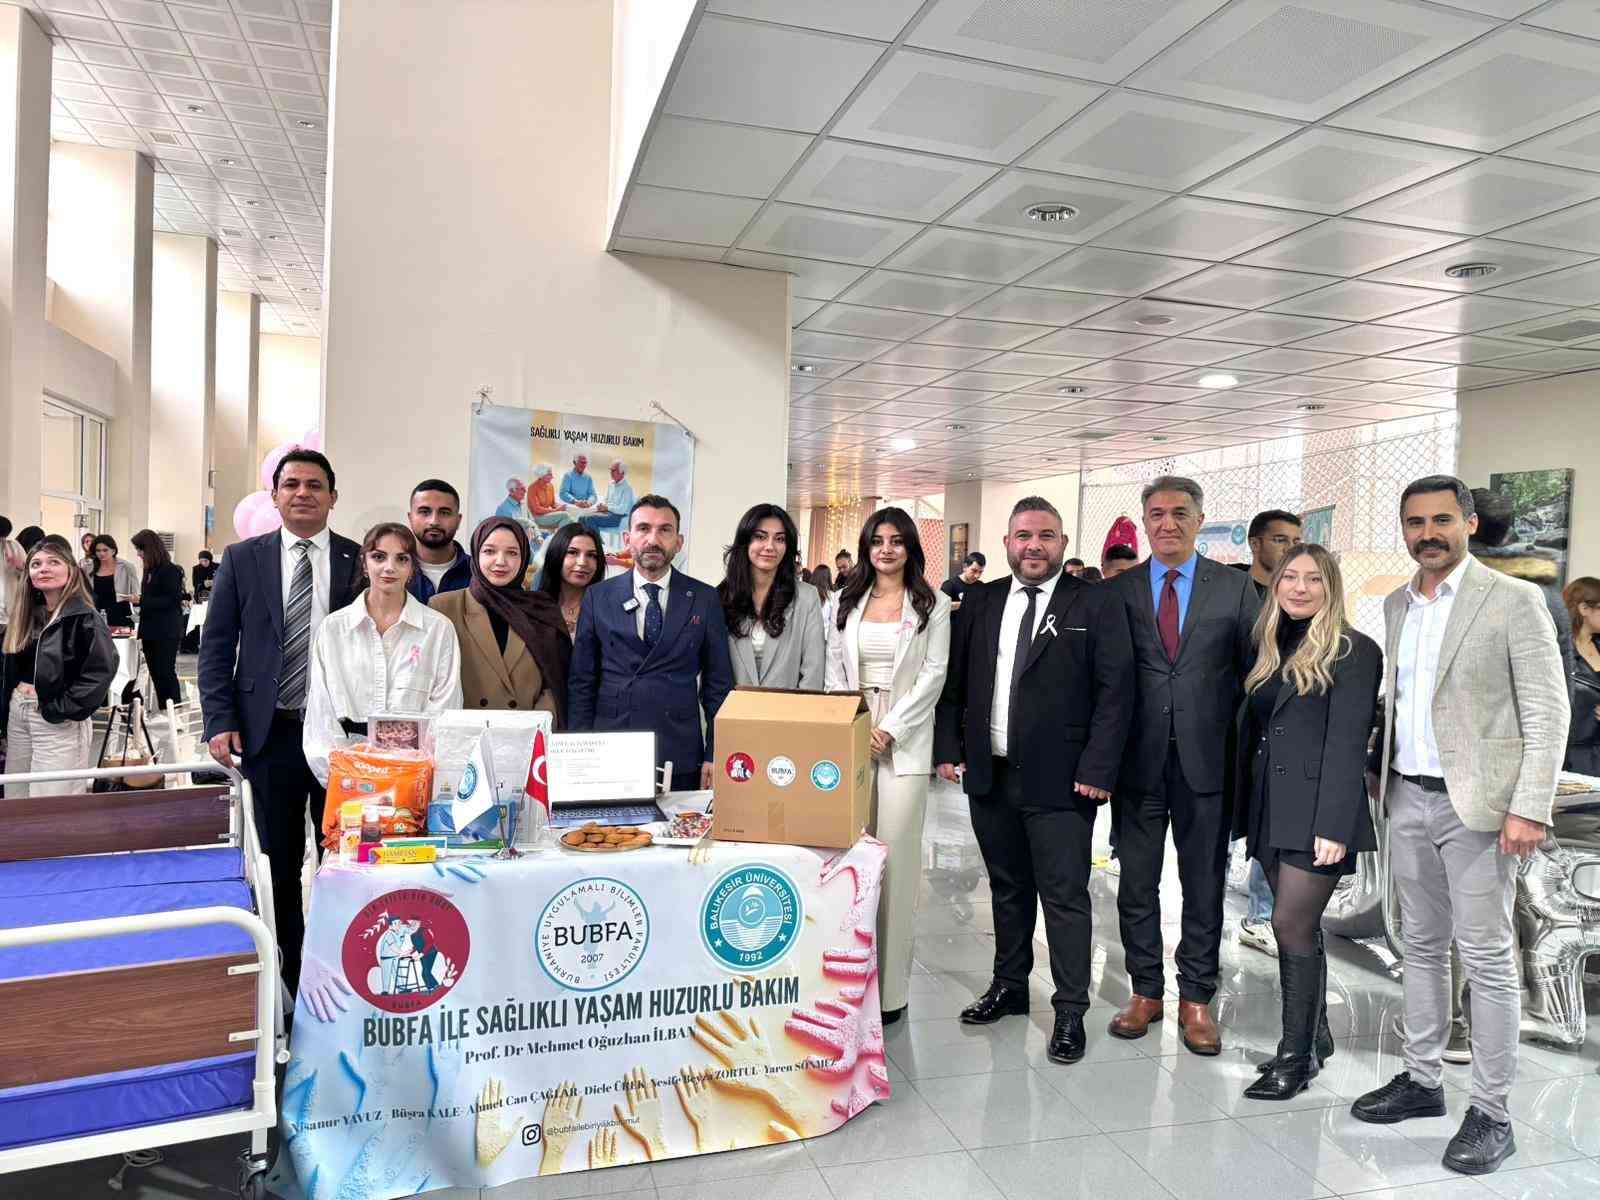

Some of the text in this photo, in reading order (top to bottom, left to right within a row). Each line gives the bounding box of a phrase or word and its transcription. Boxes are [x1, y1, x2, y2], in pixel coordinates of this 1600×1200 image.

[530, 425, 645, 448] SAĞLIKLI YAŞAM HUZURLU BAKIM
[544, 883, 605, 928] UYGULAMALI
[710, 872, 793, 929] BALIKESİR ÜNİVERSİTESİ
[553, 920, 633, 947] BUBFA
[580, 953, 604, 964] 2007
[740, 951, 764, 962] 1992
[363, 976, 799, 1047] BUBFA İLE SAĞLIKLI YAŞAM HUZURLU BAKIM
[465, 1025, 696, 1065] Prof. Dr Mehmet Oğuzhan İLBAN
[342, 1109, 382, 1125] YAVUZ
[391, 1107, 424, 1121] Büşra
[468, 1099, 503, 1114] Ahmet
[506, 1094, 528, 1106] Can
[584, 1084, 612, 1096] Dicle
[763, 1064, 793, 1075] Yaren
